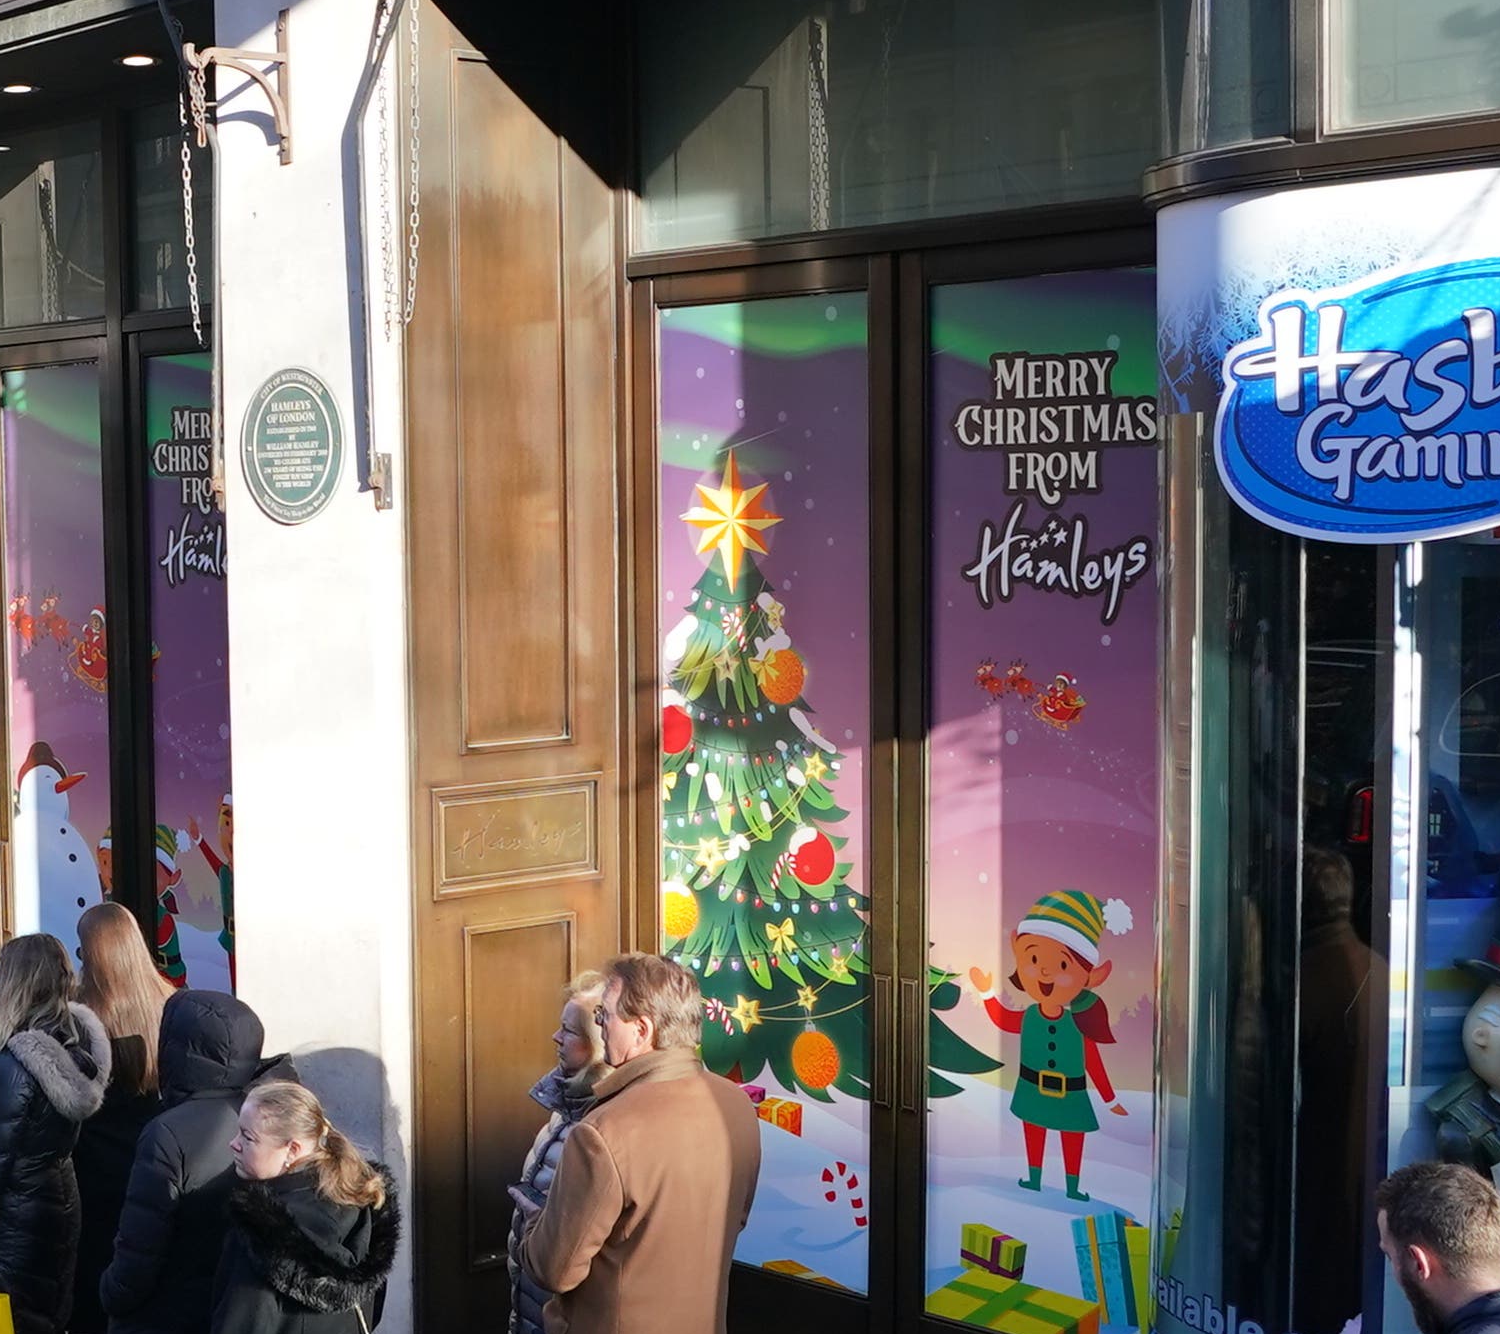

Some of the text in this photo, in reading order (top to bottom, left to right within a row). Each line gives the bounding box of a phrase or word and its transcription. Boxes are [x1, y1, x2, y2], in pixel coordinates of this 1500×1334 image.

[993, 357, 1112, 400] MERRY
[271, 400, 312, 412] HAMLEYS
[279, 411, 316, 424] LONDON
[955, 403, 1157, 446] CHRISTMAS
[1008, 451, 1097, 504] FROM
[966, 503, 1147, 619] Hamleys
